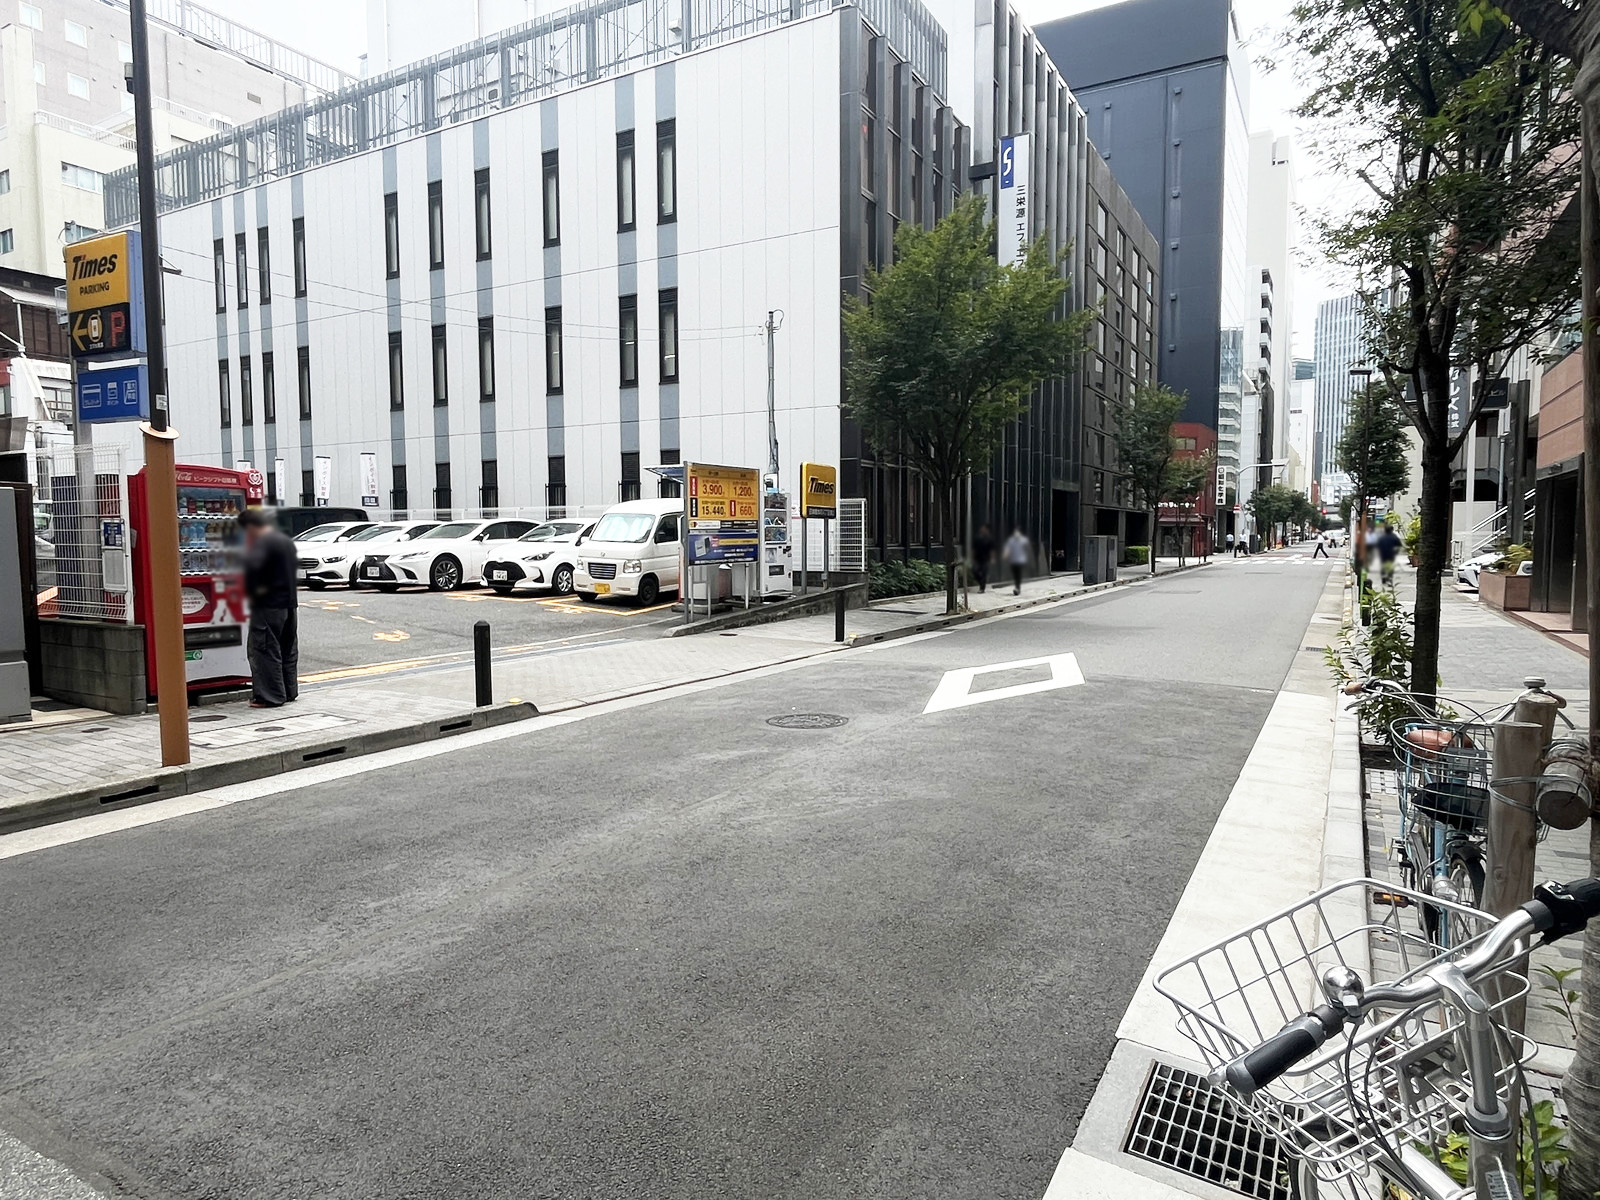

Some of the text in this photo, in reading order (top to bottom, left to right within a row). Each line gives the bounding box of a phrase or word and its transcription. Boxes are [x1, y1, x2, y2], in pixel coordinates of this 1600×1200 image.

[72, 254, 118, 280] Times
[80, 281, 110, 296] PARKING
[808, 476, 835, 494] Times
